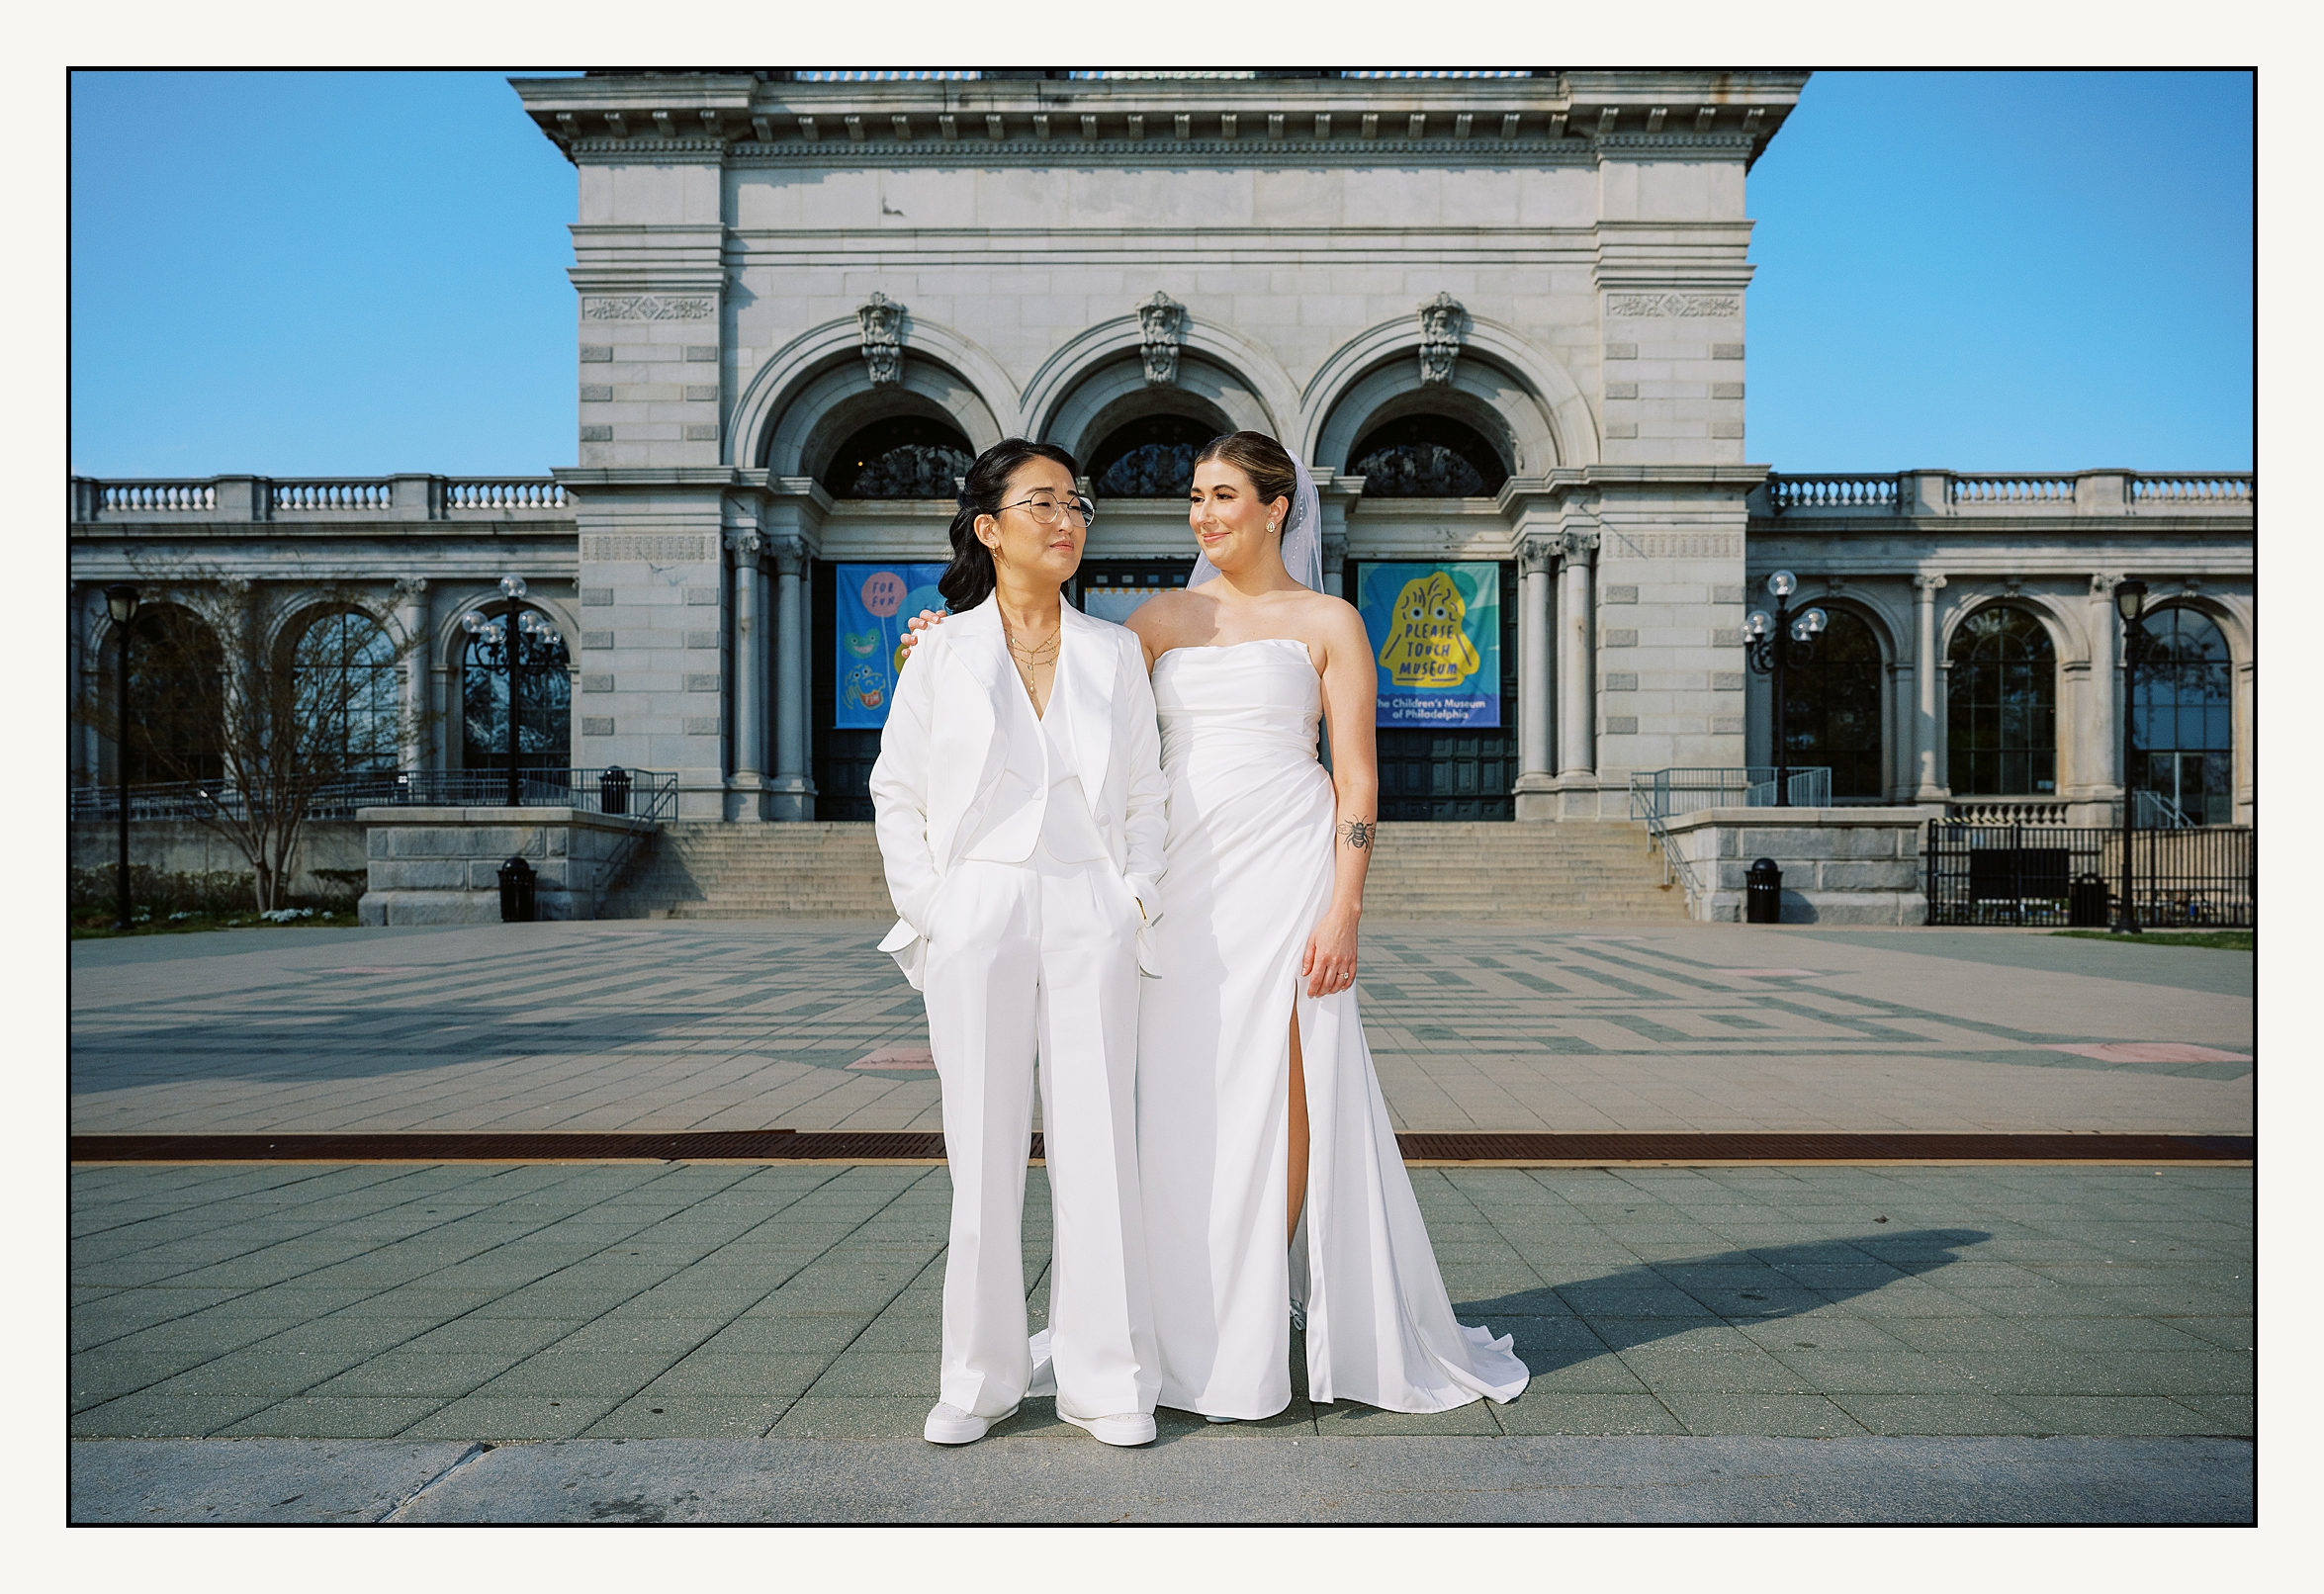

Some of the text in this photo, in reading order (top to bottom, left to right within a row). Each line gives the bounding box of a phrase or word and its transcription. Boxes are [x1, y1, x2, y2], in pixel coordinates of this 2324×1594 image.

[872, 581, 894, 593] FOR
[1405, 623, 1454, 639] PLEASE
[1407, 642, 1451, 658] TOUCH
[1399, 661, 1458, 676] MUSEUM
[1377, 698, 1485, 708] he Children's Museum
[1392, 709, 1469, 721] of Philadelphia
